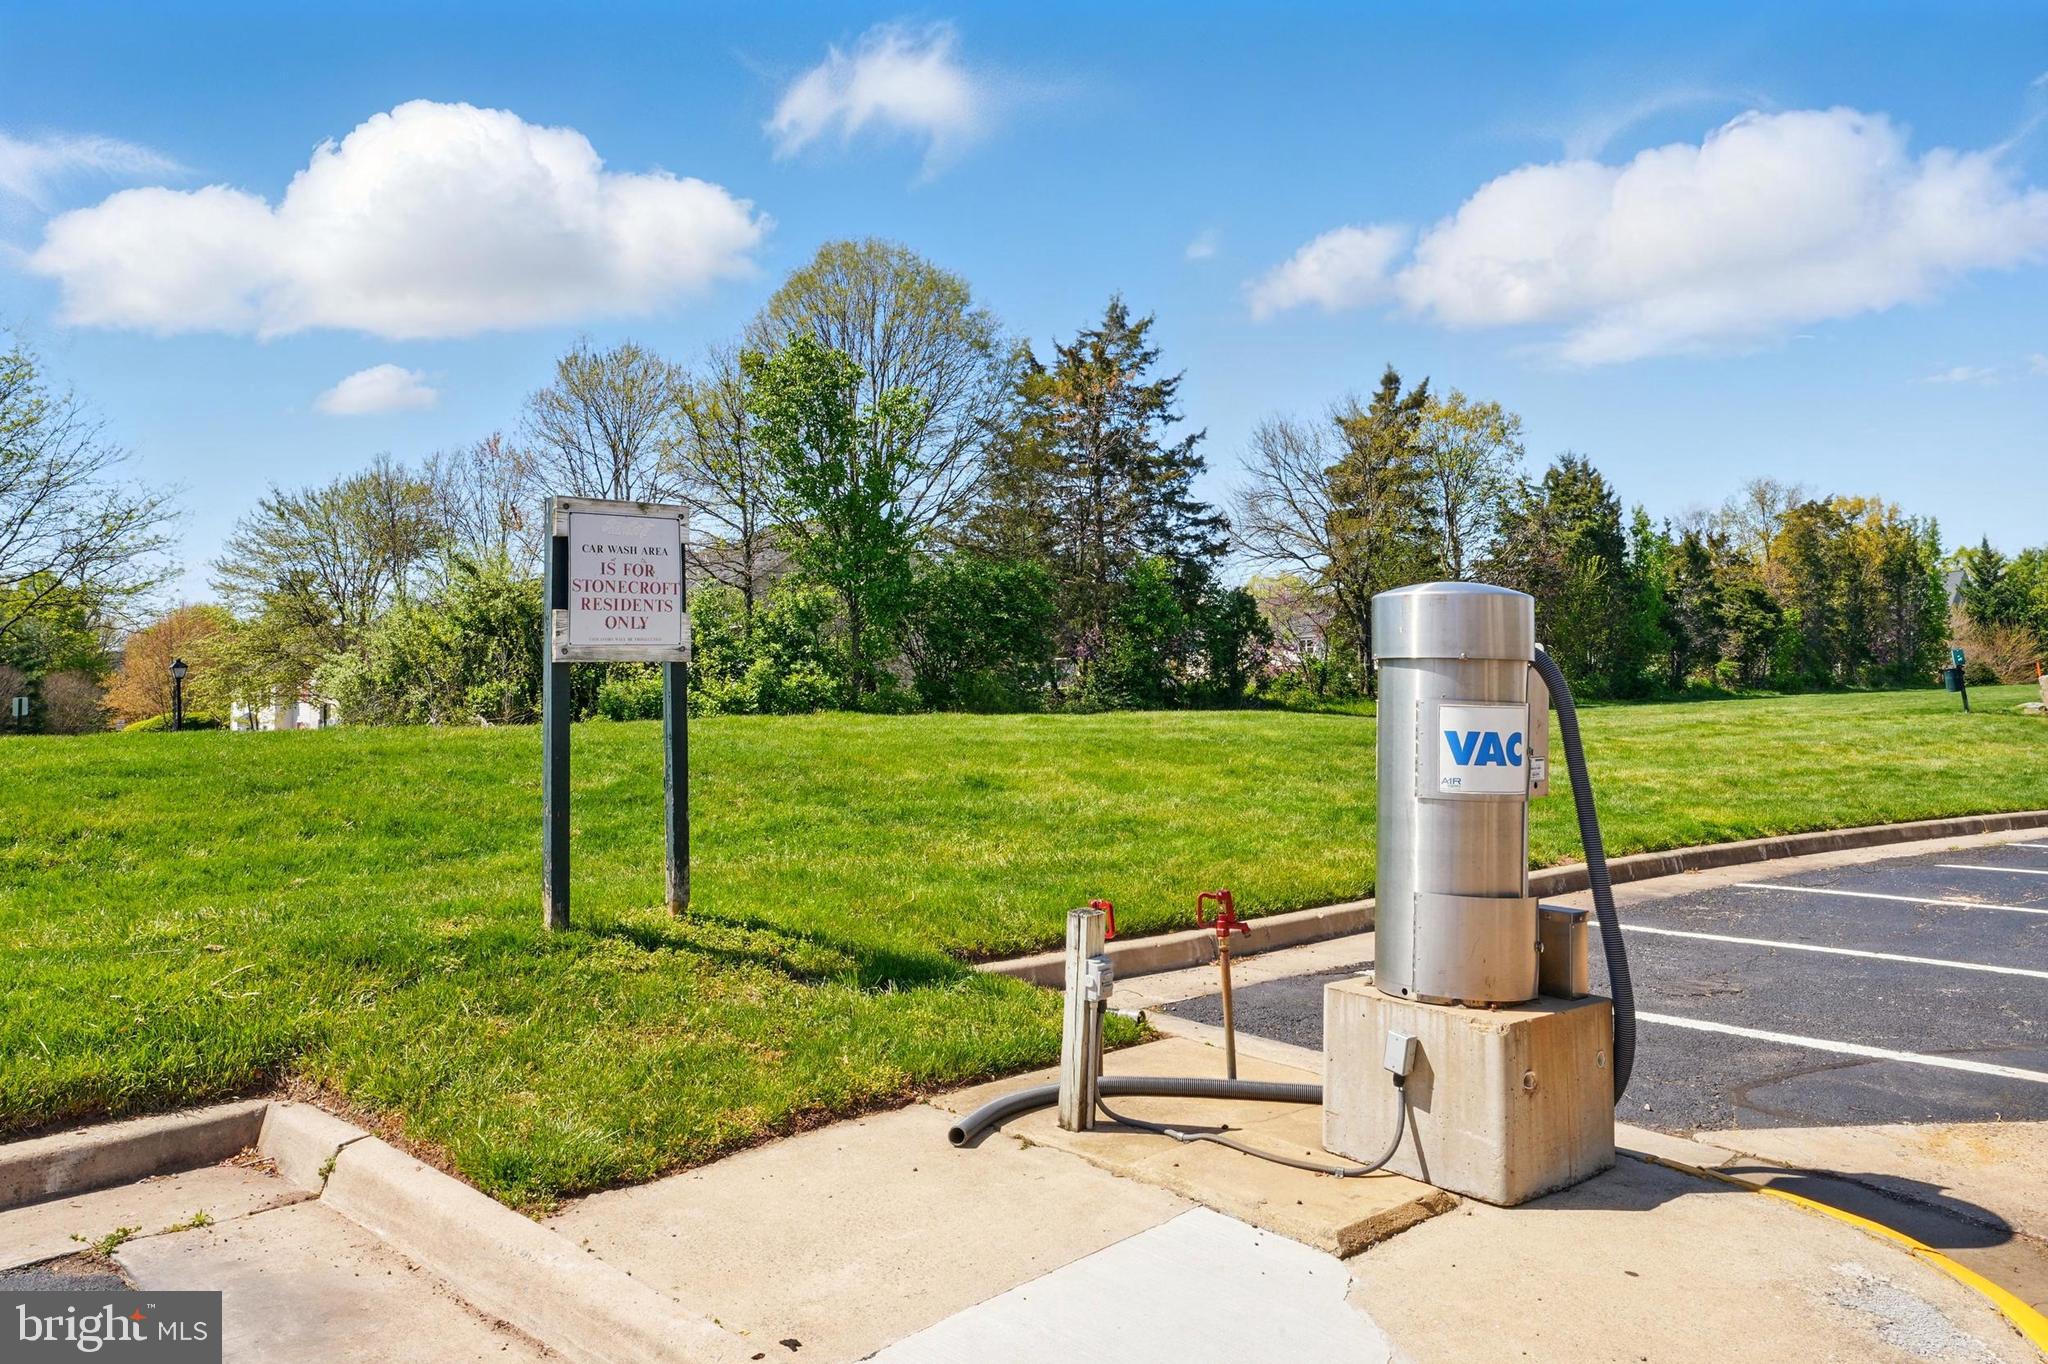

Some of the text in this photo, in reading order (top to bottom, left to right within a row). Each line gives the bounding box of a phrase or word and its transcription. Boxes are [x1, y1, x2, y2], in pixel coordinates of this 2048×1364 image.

[582, 544, 668, 556] CAR WASH AREA
[601, 562, 655, 577] IS FOR
[572, 578, 680, 595] STONECROFT
[581, 597, 673, 612] RESIDENTS
[605, 615, 649, 630] ONLY
[1444, 730, 1522, 767] VAC
